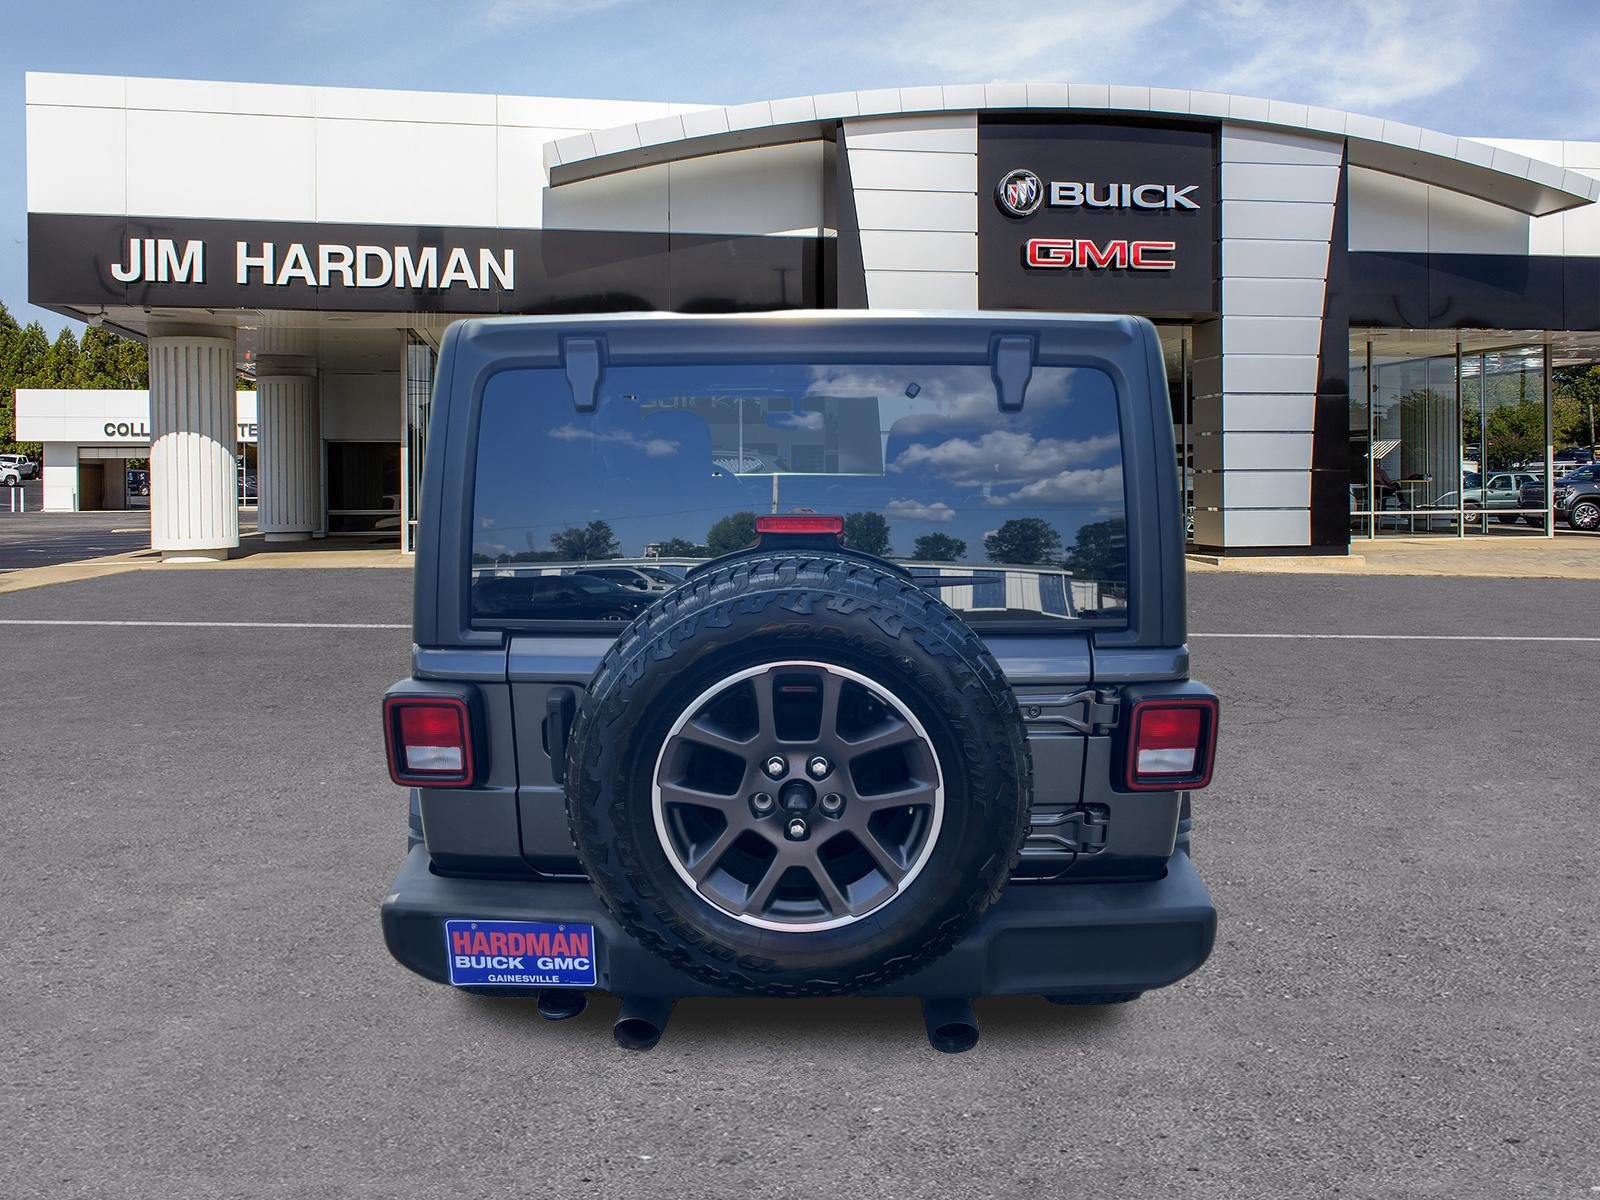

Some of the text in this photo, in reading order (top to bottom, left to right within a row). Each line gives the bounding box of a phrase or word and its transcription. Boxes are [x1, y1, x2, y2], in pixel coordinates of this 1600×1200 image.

[1050, 181, 1200, 209] BUICK
[111, 238, 516, 291] JIM HARDMAN
[1025, 238, 1177, 270] GMC
[104, 422, 151, 437] COLL
[452, 931, 589, 957] HARDMAN
[455, 956, 590, 970] BUICK GMC
[488, 974, 560, 983] GAINESVILLE
